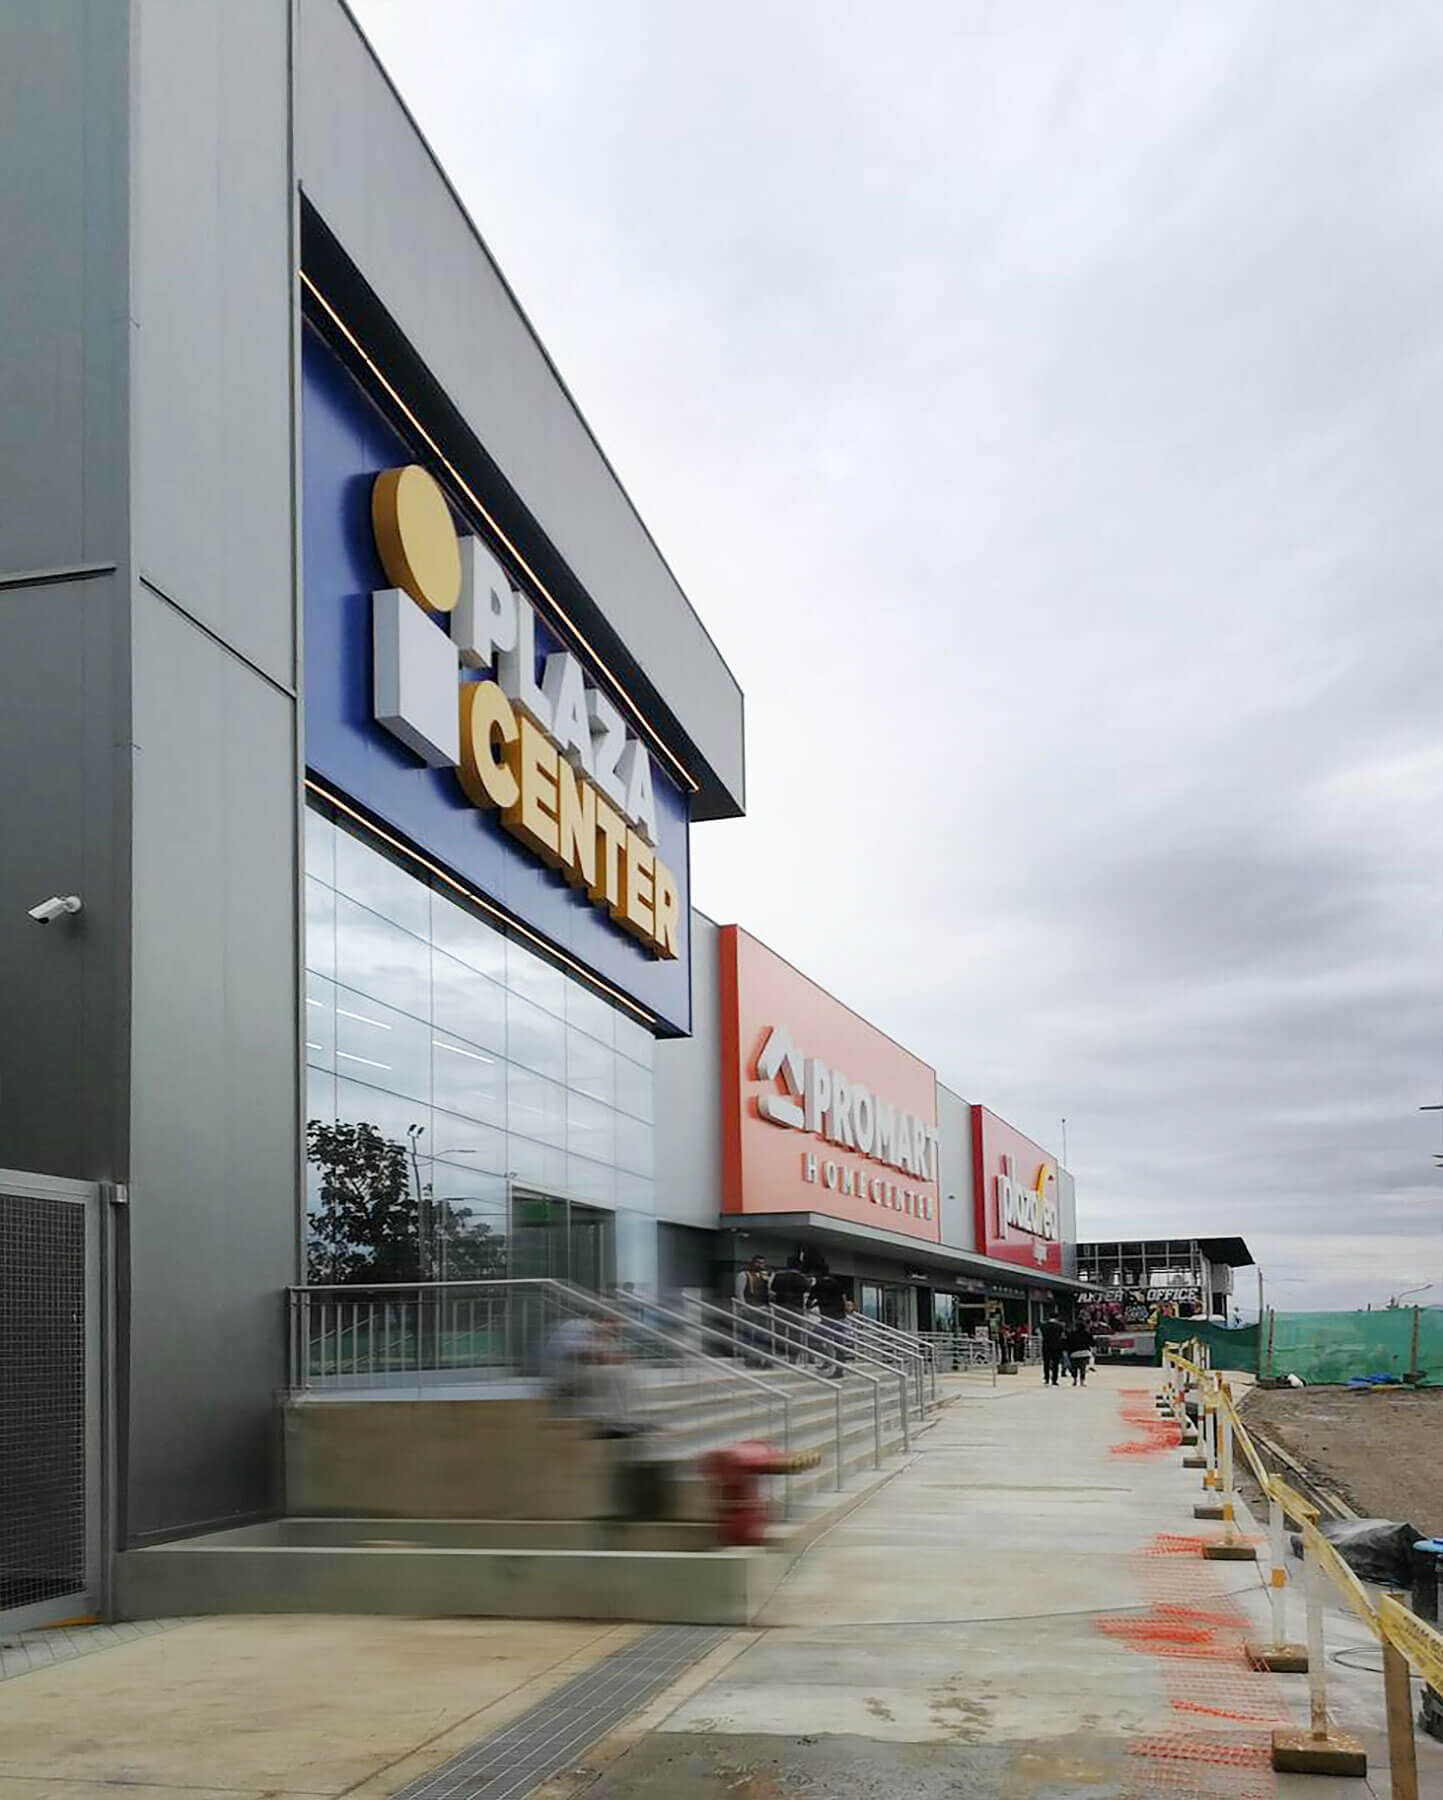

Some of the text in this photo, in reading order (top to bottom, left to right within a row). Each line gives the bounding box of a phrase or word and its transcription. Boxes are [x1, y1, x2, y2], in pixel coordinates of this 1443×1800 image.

[451, 534, 660, 847] PLAZA
[457, 680, 679, 961] CENTER
[805, 1058, 939, 1182] PROMART
[1147, 1287, 1199, 1302] OFFICE
